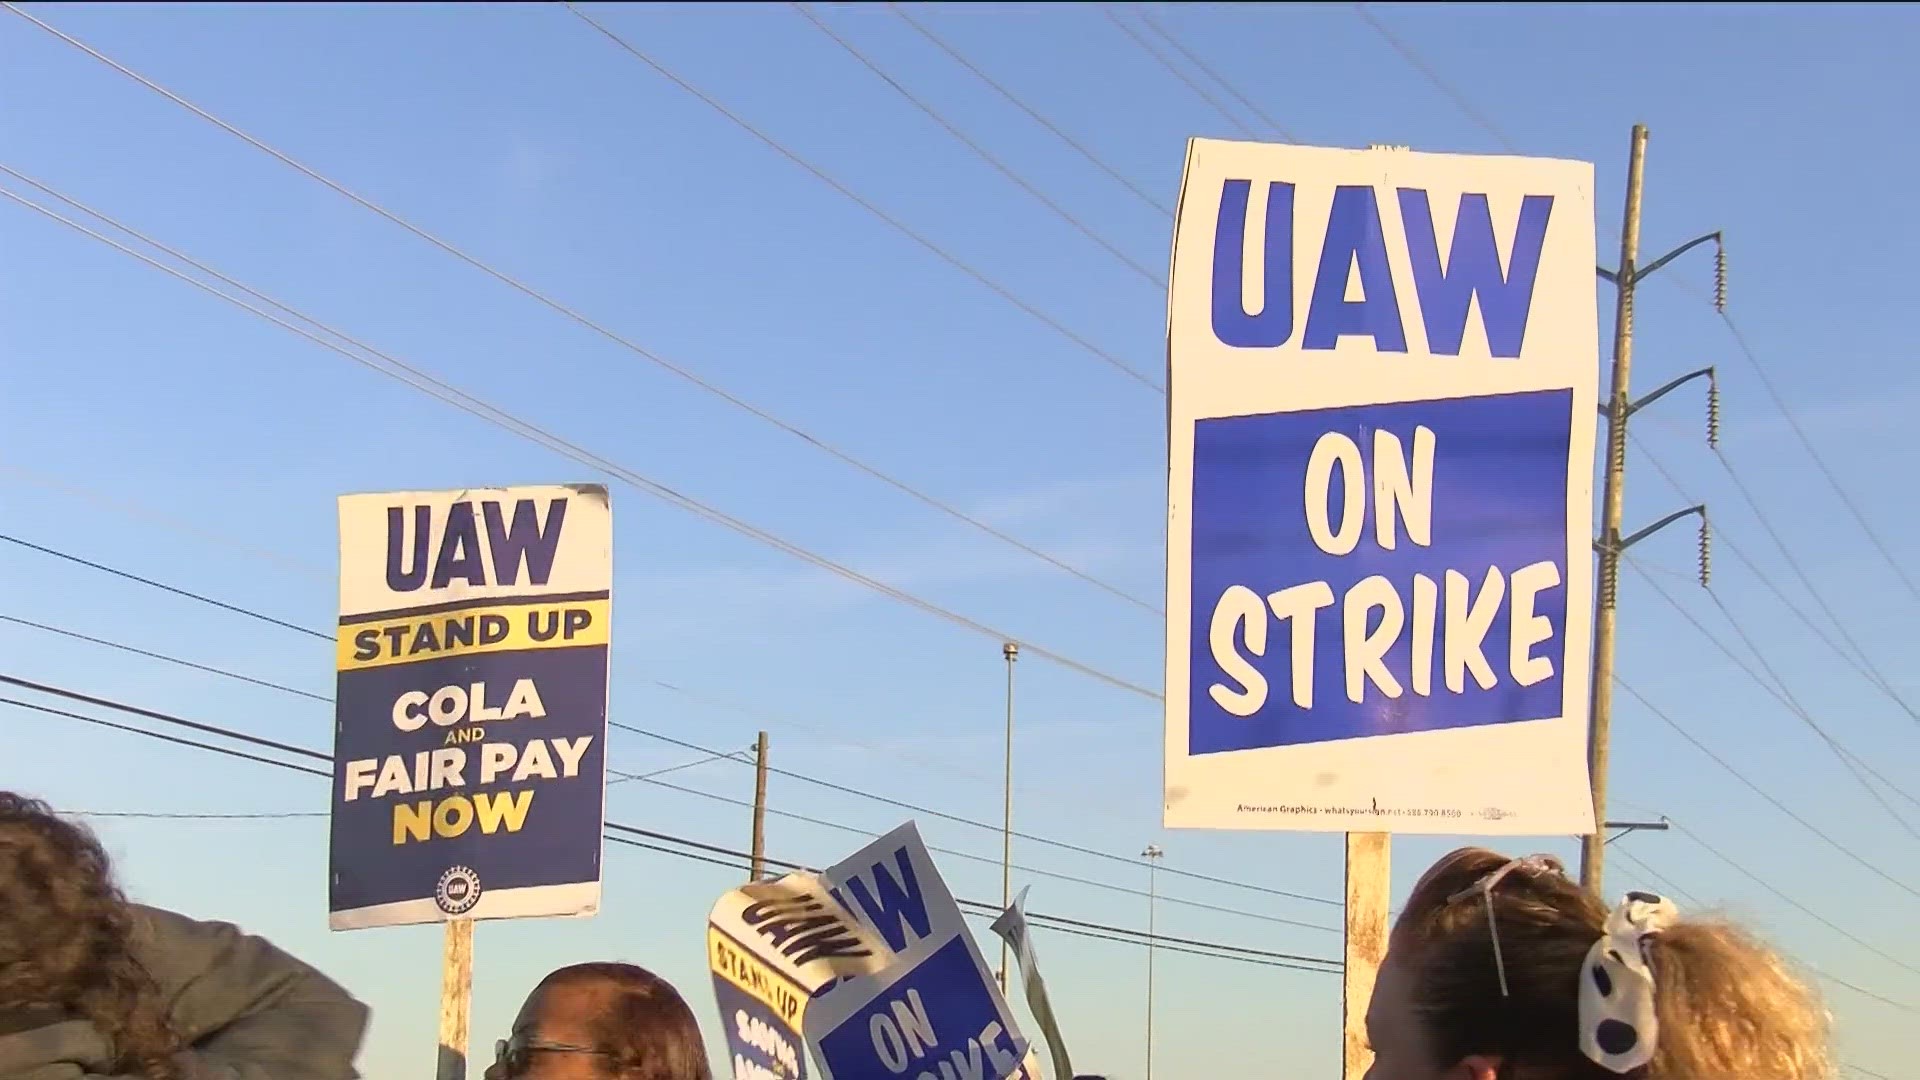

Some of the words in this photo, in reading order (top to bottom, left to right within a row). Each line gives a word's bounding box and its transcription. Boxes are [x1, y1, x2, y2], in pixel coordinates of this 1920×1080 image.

[1212, 179, 1555, 359] UAW
[1304, 425, 1436, 556] ON
[386, 498, 568, 592] UAW
[353, 614, 510, 662] STAND
[527, 609, 593, 642] UP
[1208, 560, 1561, 716] STRIKE
[392, 678, 547, 733] COLA
[443, 727, 486, 746] AND
[344, 747, 467, 802] FAIR
[480, 735, 594, 784] PAY
[392, 789, 536, 845] NOW
[1280, 805, 1317, 815] Graphics
[869, 988, 938, 1074] ON
